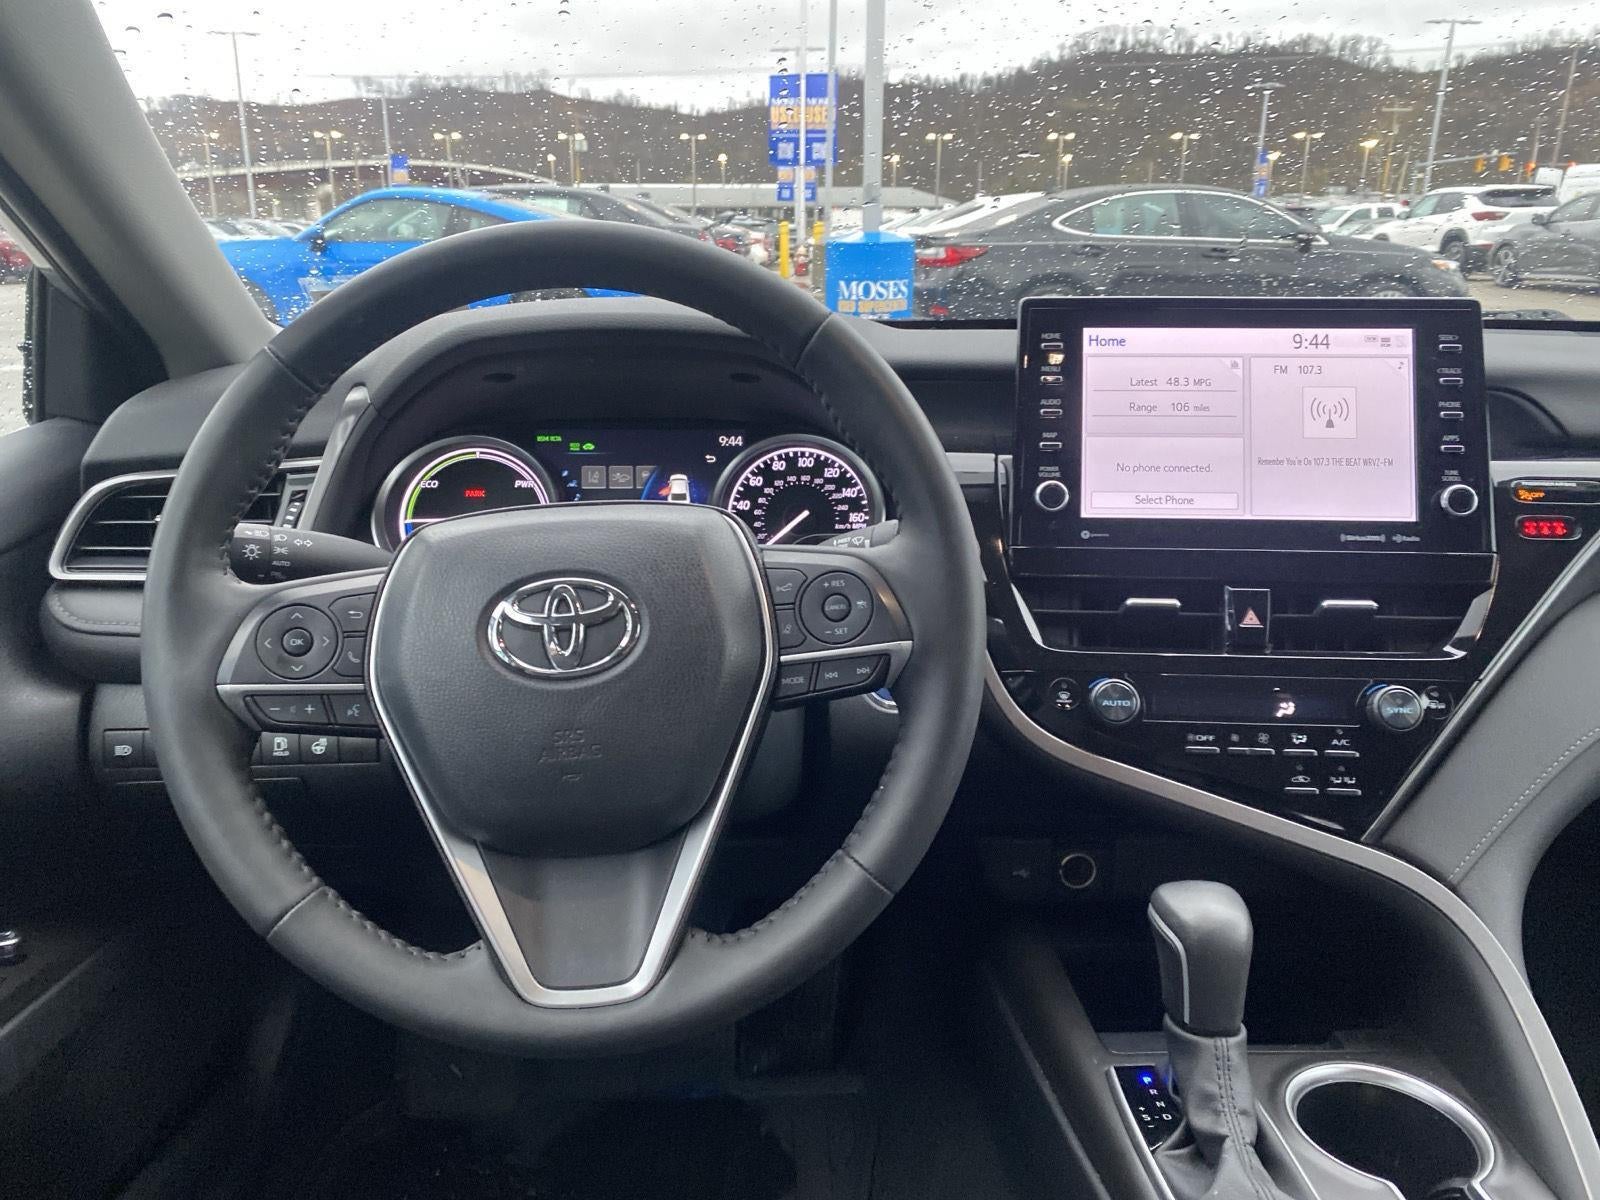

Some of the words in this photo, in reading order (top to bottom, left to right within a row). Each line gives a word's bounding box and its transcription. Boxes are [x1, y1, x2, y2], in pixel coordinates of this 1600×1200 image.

[838, 280, 908, 300] MOSES
[1088, 335, 1127, 347] Home
[1292, 333, 1331, 349] 9:44
[1273, 365, 1288, 374] FM
[1298, 365, 1323, 375] 107.3
[1129, 377, 1158, 387] Latest
[1166, 377, 1190, 387] 48.3
[1193, 378, 1212, 387] MPG
[1129, 402, 1158, 413] Range
[1171, 402, 1190, 412] 106
[1194, 404, 1210, 412] miles
[719, 436, 743, 447] 9:44
[772, 461, 786, 471] 80
[797, 458, 815, 468] 100
[1313, 458, 1330, 466] 107.3
[1331, 458, 1344, 466] THE
[1345, 458, 1361, 466] BEAT
[824, 468, 840, 478] 120
[1116, 463, 1131, 472] No
[1133, 463, 1161, 474] phone
[1163, 464, 1213, 473] connected.
[420, 480, 439, 488] ECO
[514, 480, 535, 488] PWR
[750, 476, 763, 487] 60
[465, 489, 486, 497] PARK
[842, 488, 858, 498] 140
[1135, 495, 1162, 504] Select
[1165, 495, 1195, 505] Phone
[736, 500, 751, 511] 40
[849, 512, 865, 523] 160
[834, 627, 849, 635] SET
[290, 638, 304, 646] OK
[781, 676, 805, 685] MODE
[1386, 706, 1415, 714] SYNC
[1196, 734, 1216, 742] OFF
[1331, 738, 1351, 746] A/C
[1162, 1113, 1173, 1121] D
